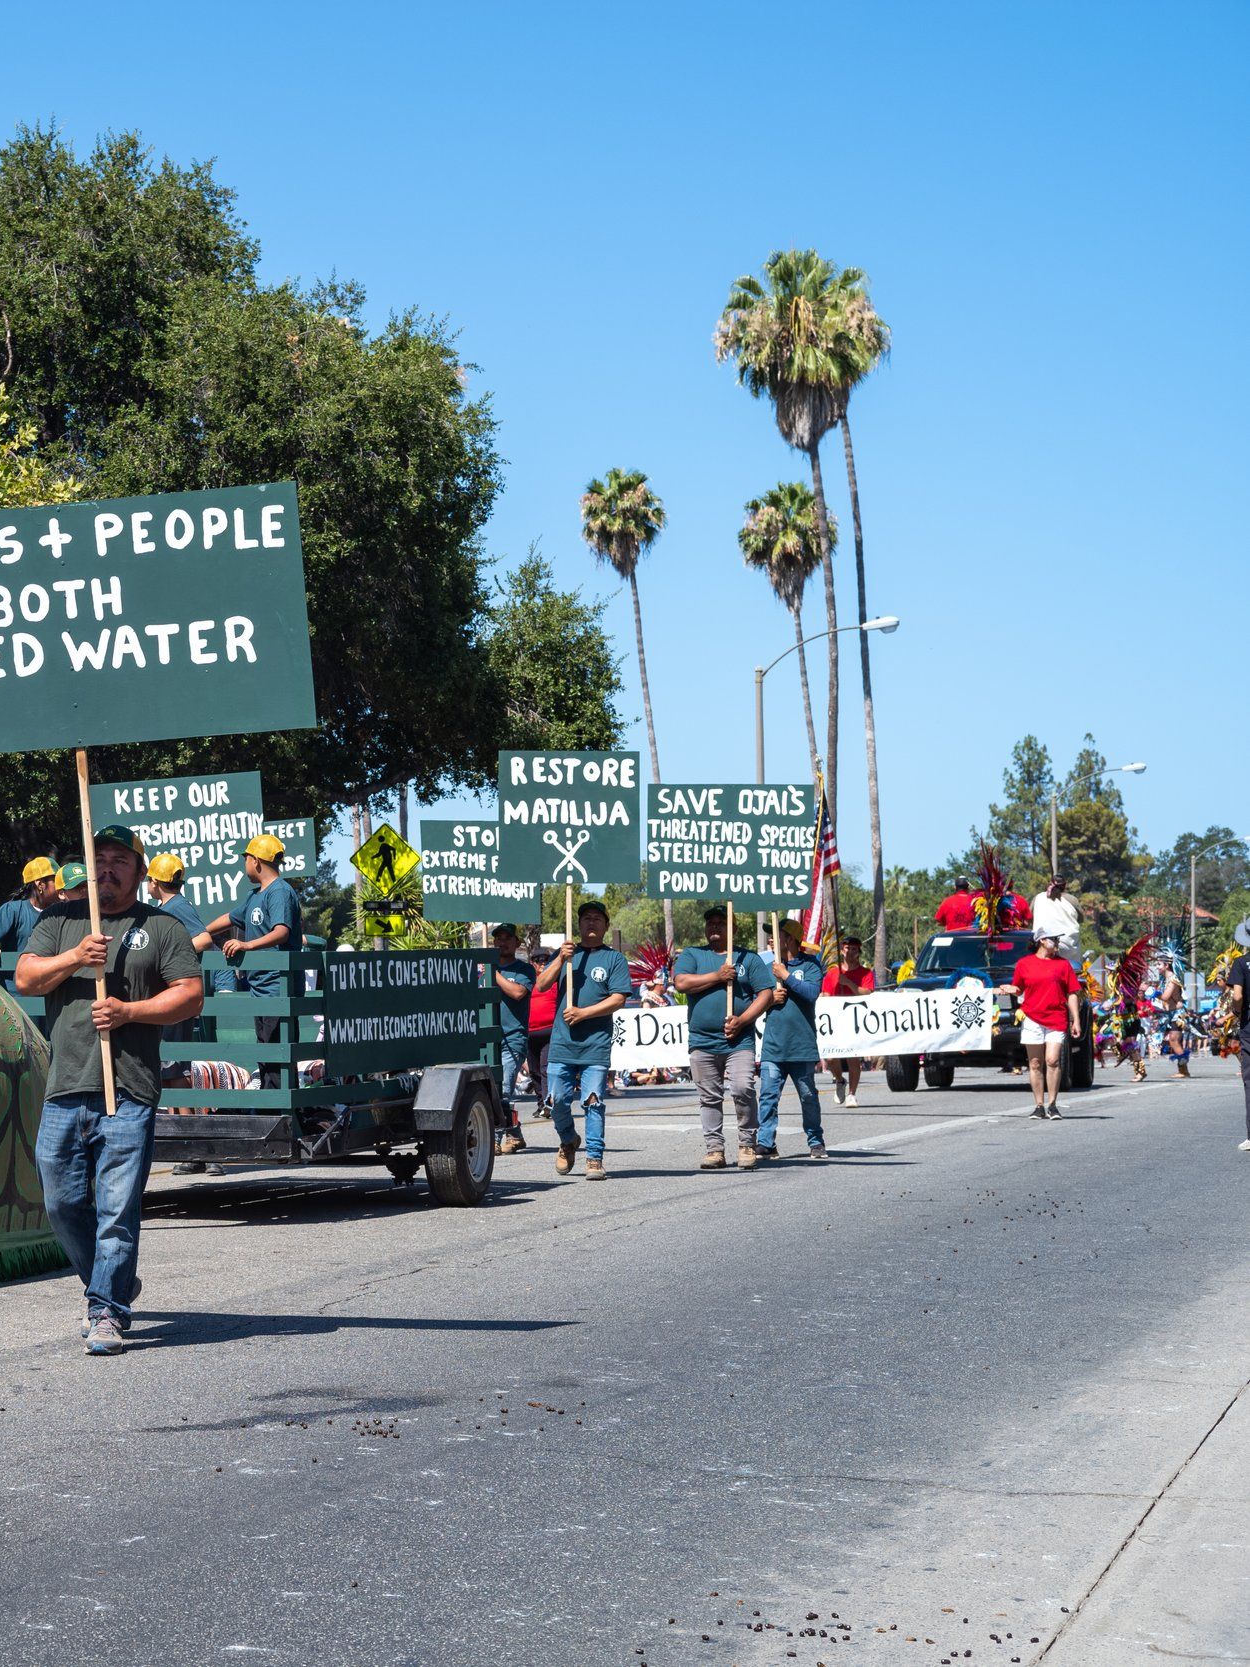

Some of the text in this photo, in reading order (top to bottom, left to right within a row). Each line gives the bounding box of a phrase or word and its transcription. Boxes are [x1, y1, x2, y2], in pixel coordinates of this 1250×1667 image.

[95, 504, 285, 557] PEOPLE
[61, 615, 258, 671] WATER
[510, 756, 636, 788] RESTORE
[114, 780, 230, 815] KEEP OUR
[503, 797, 630, 827] MATILIJA
[657, 785, 806, 816] SAVE OJAI'S
[130, 811, 264, 846] RSHED HEALTHY
[264, 821, 306, 838] TECT
[647, 819, 816, 849] THREATENED SPECIES
[209, 840, 239, 865] US
[422, 850, 487, 871] EXTREME
[647, 842, 815, 870] STEELHEAD TROUT
[422, 874, 482, 896] EXTREME
[659, 870, 809, 896] POND TURTLES
[330, 957, 473, 991] TURTLE CONSERVANCY
[843, 997, 940, 1035] Tonalli
